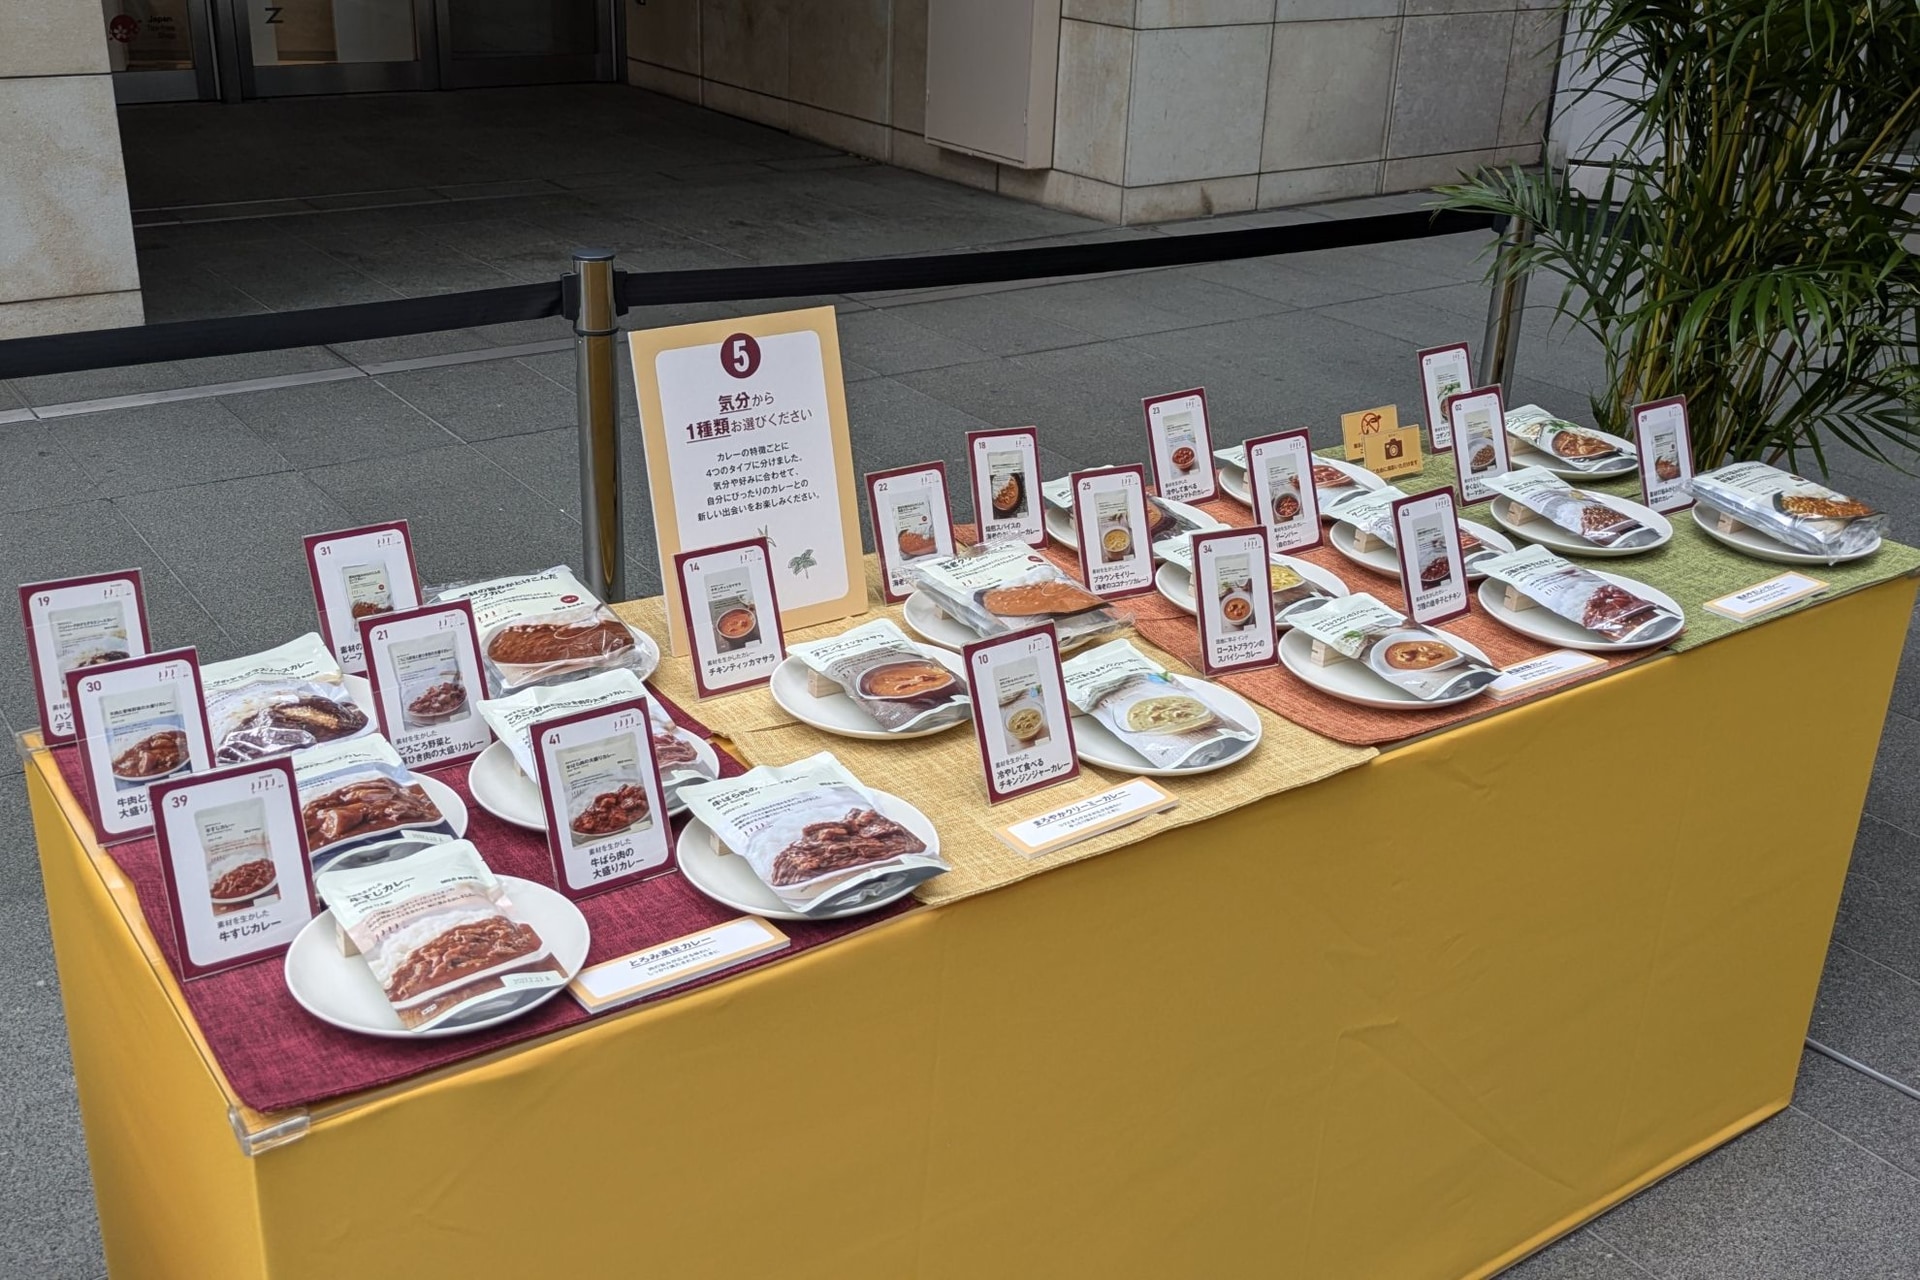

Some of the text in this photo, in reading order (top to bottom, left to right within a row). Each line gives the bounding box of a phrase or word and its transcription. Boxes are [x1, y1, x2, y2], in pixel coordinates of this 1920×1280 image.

[148, 15, 173, 23] Japan
[733, 339, 750, 373] 5
[718, 391, 775, 412] 気分から
[1152, 407, 1160, 415] 23
[686, 407, 813, 440] 1種類お選びください
[717, 442, 790, 462] カレーの特徴ごとに
[1255, 448, 1264, 456] 33
[706, 455, 803, 478] 4つのタイプに分けました。
[713, 468, 800, 491] 気分や好みに合わせて、
[1082, 482, 1091, 491] 25
[706, 479, 809, 507] 自分にぴったりのカレーとの
[878, 483, 888, 492] 22
[697, 493, 821, 522] 新しい出会いをお楽しみください。
[1402, 508, 1410, 516] 43
[320, 546, 332, 556] 31
[1203, 545, 1213, 554] 34
[689, 562, 700, 572] 14
[38, 596, 50, 607] 19
[376, 630, 388, 641] 21
[1216, 640, 1265, 654] ローストブラウンの
[342, 652, 363, 664] ビーフ
[978, 654, 989, 665] 10
[1218, 650, 1262, 663] スパイシーカレー
[708, 654, 776, 676] チキンティッカマサラ
[86, 680, 102, 692] 30
[56, 722, 73, 732] デミ
[398, 736, 452, 756] ごろごろ野菜と
[549, 734, 561, 746] 41
[996, 758, 1045, 780] 冷やして食べる
[998, 762, 1070, 790] チキンジンジャーカレー
[116, 794, 146, 808] 牛肉と
[172, 794, 188, 808] 39
[119, 804, 153, 819] 大盛り
[1032, 790, 1126, 827] まろやかクリーミーカレー
[590, 847, 634, 868] 牛ばら肉の
[592, 858, 645, 880] 大盛りカレー
[349, 877, 416, 903] 牛すじカレー
[216, 909, 270, 928] 素材を生かした
[218, 919, 282, 942] 牛すじカレー
[628, 936, 712, 968] とろみ満足カレー
